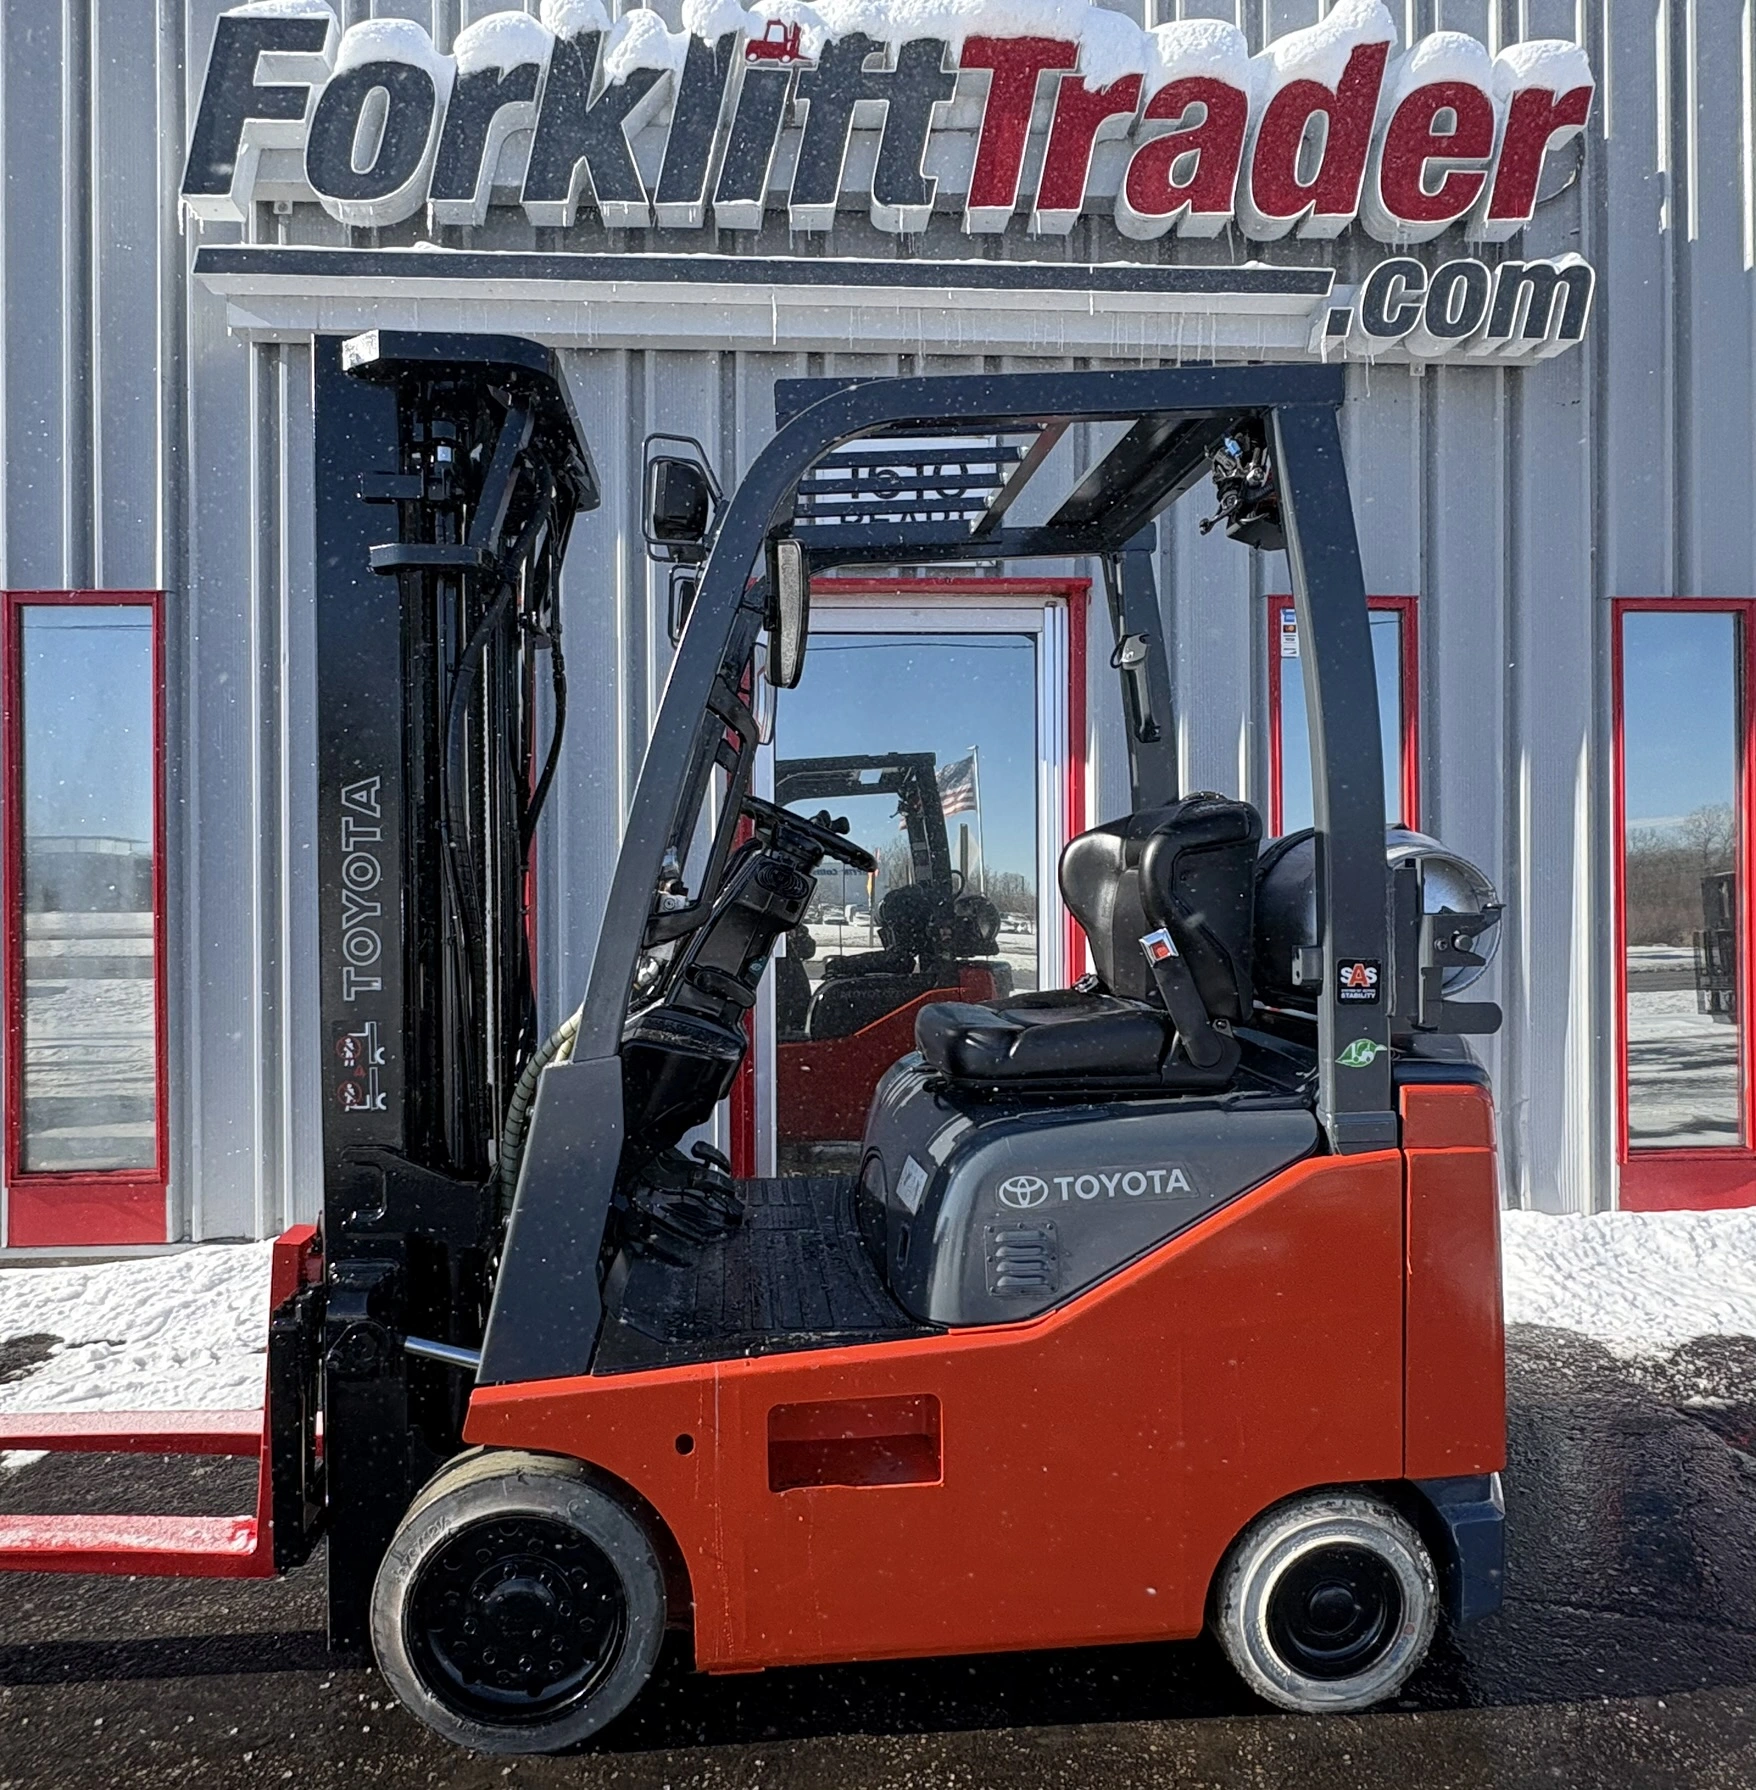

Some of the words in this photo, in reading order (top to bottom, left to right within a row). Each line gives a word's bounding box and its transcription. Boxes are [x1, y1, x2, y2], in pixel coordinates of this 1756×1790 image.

[1324, 257, 1595, 342] .com
[341, 775, 382, 1002] TOYOTA
[1340, 963, 1378, 987] SAS
[1053, 1168, 1190, 1201] TOYOTA
